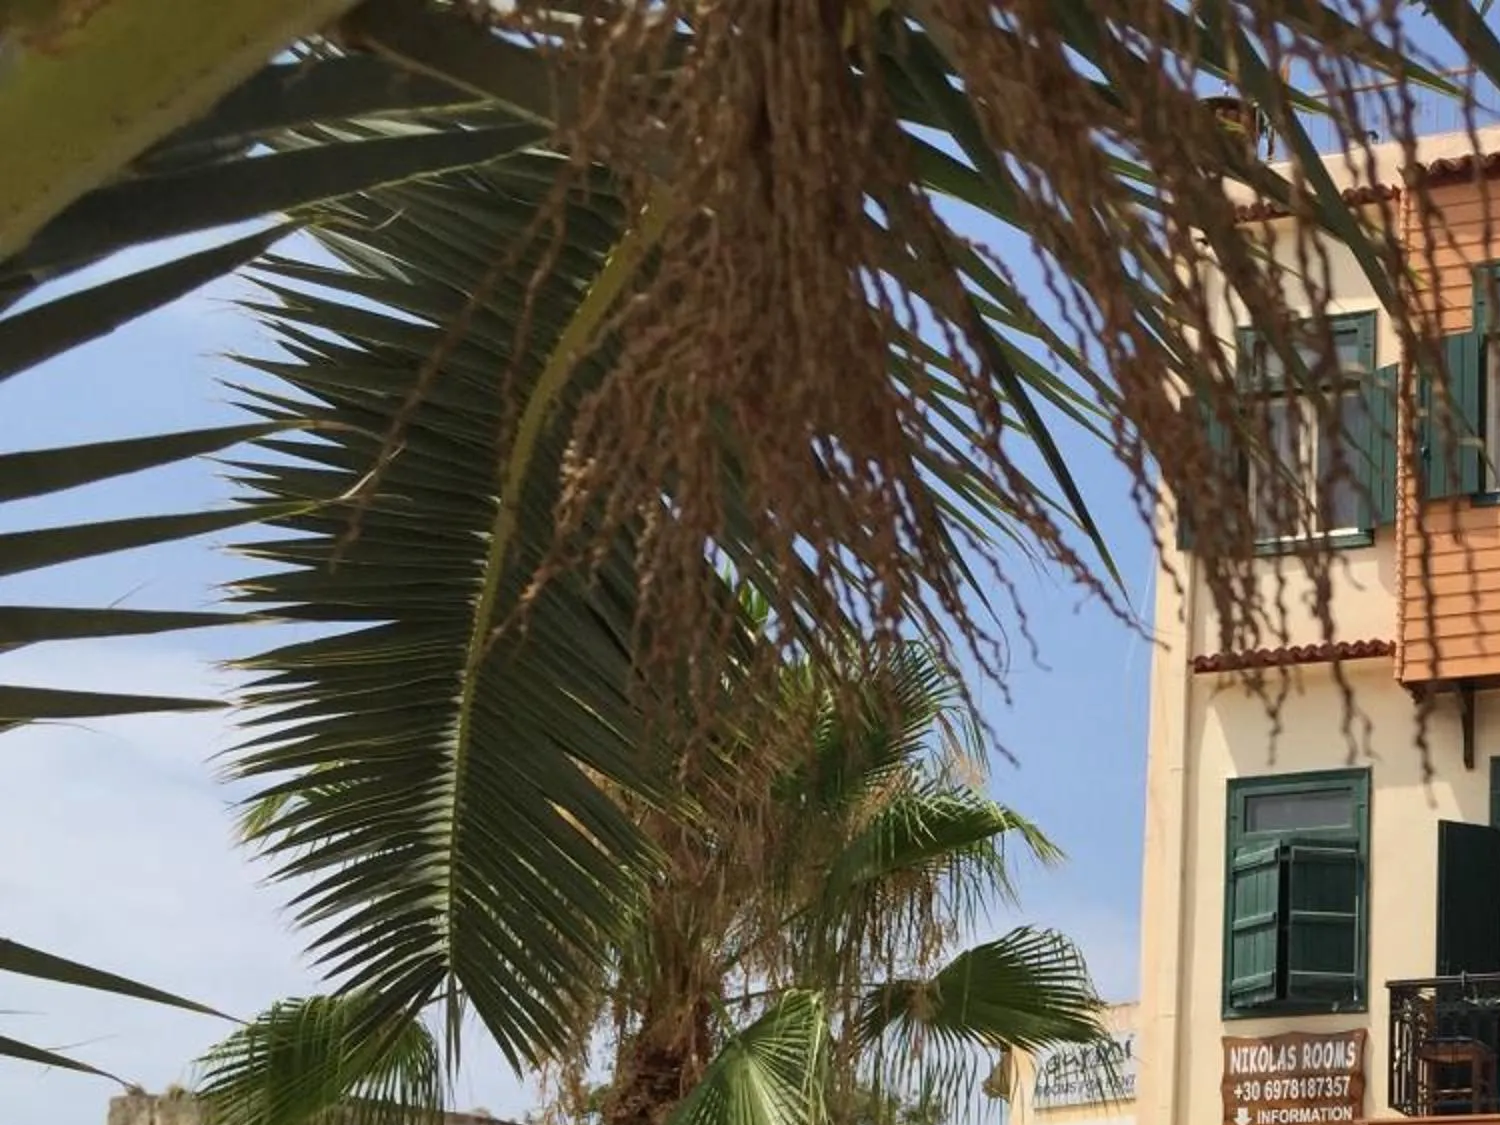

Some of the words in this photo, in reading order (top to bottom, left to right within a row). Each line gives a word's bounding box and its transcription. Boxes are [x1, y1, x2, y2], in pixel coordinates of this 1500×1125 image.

[1230, 1045, 1297, 1074] NIKOLAS
[1302, 1041, 1356, 1069] ROOMS
[1233, 1081, 1261, 1101] +30
[1264, 1075, 1351, 1101] 6978187357
[1257, 1106, 1353, 1125] INFORMATION
